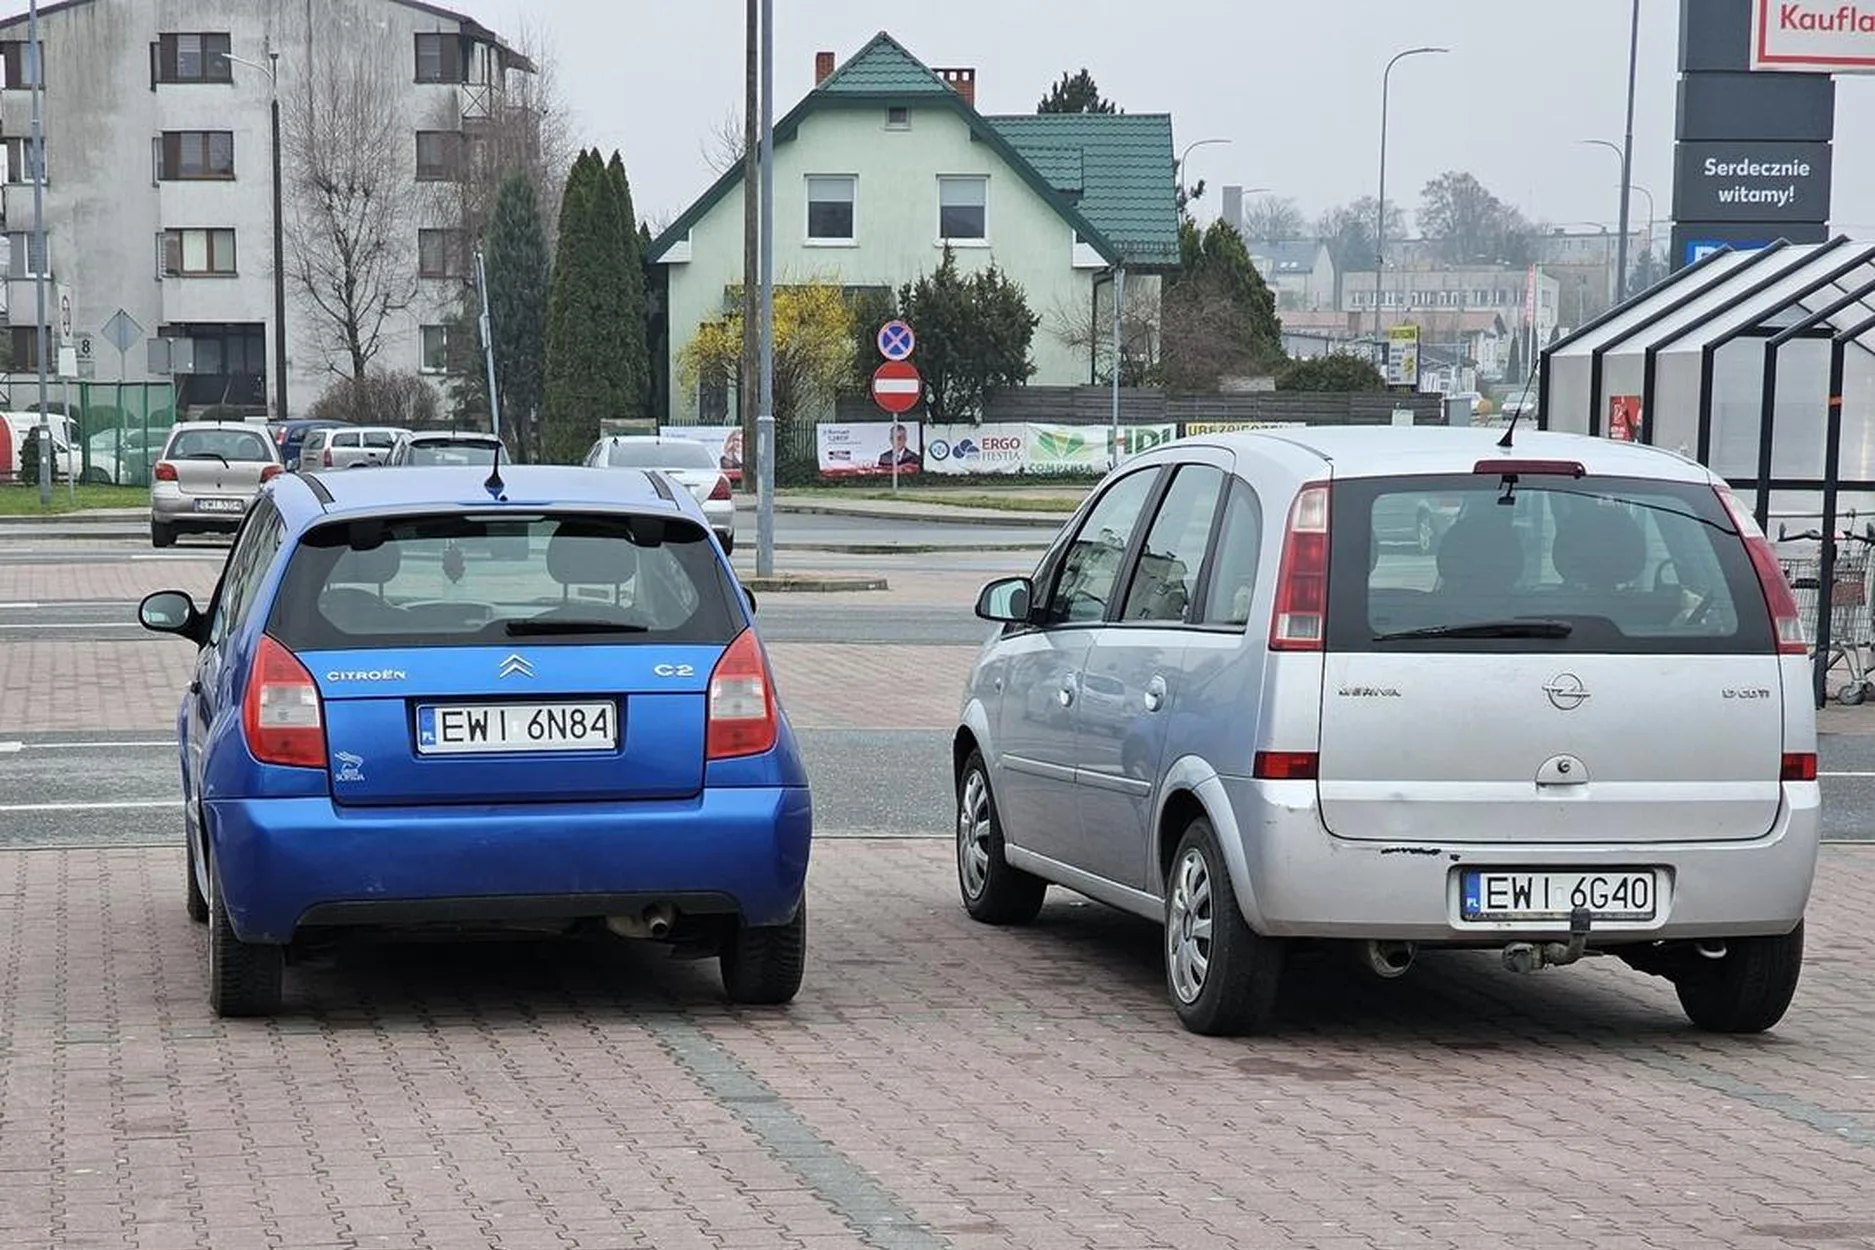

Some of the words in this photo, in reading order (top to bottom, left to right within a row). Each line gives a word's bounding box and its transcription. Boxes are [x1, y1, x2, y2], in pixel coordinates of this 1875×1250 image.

[1704, 158, 1810, 176] Serdecznie
[1718, 185, 1795, 207] witamy!
[82, 339, 90, 354] 8
[982, 438, 1020, 450] ERGO
[326, 668, 406, 681] CITROËN
[653, 664, 694, 677] C2
[441, 710, 506, 742] EWI
[527, 708, 608, 740] 6N84
[1487, 877, 1549, 909] EWI
[1571, 877, 1648, 909] 6G40
[1467, 898, 1479, 908] PL
